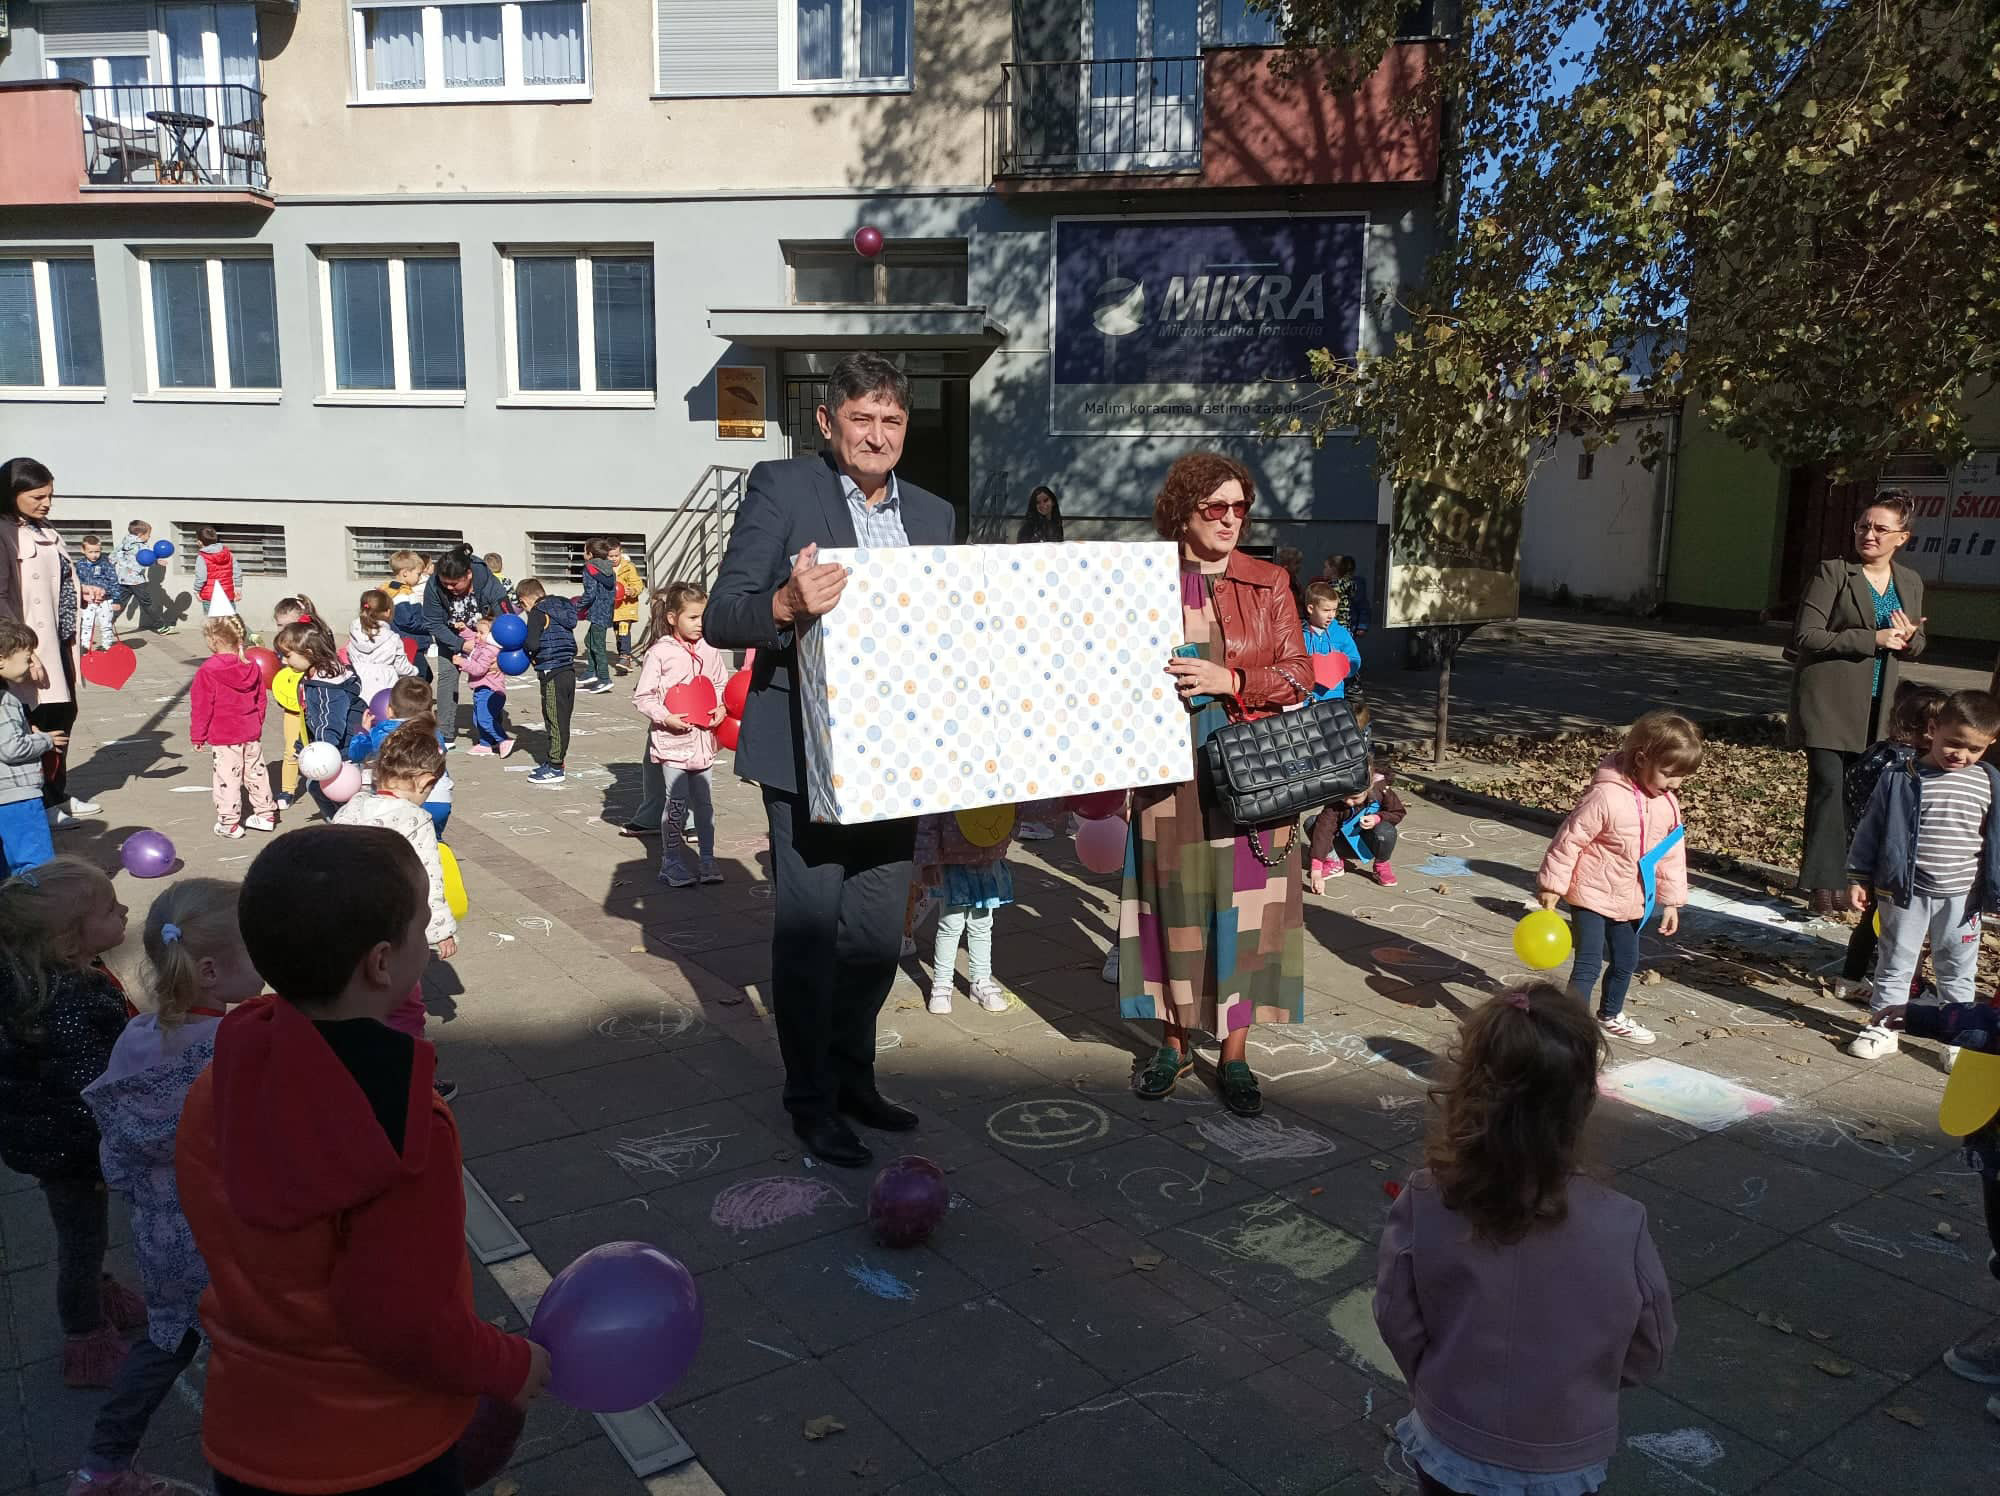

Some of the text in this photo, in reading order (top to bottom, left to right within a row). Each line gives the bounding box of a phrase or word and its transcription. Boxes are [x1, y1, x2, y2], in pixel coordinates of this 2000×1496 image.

[1159, 273, 1324, 321] MIKRA
[1257, 321, 1323, 339] fondacija
[1085, 402, 1126, 416] Malim
[1130, 401, 1192, 416] koracima
[1198, 402, 1251, 416] rastimo
